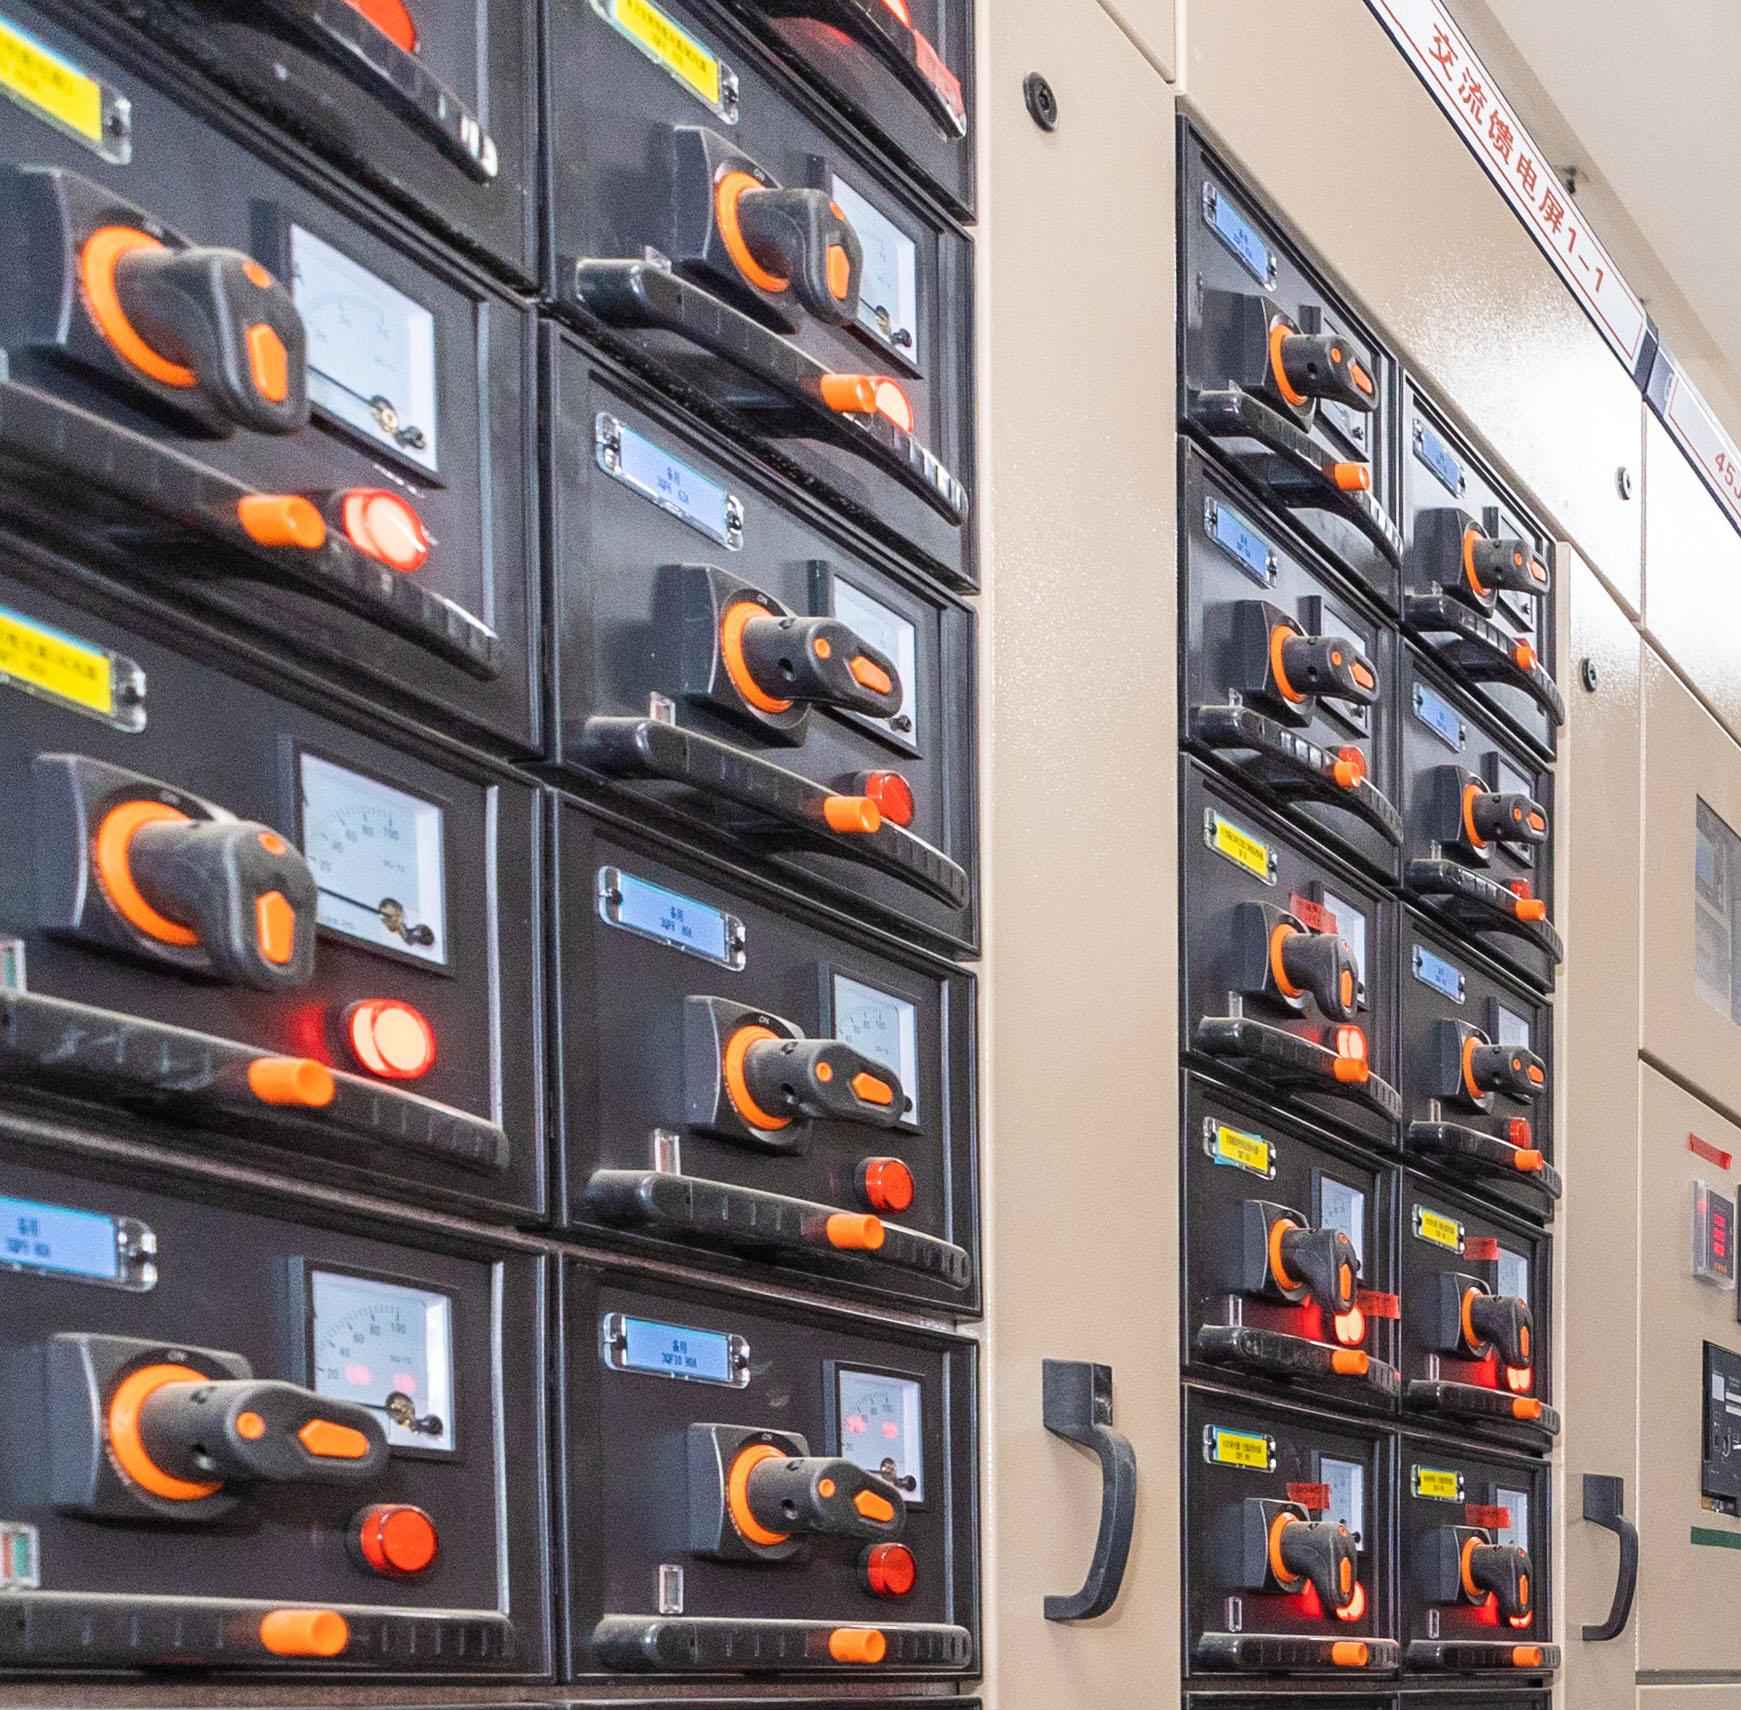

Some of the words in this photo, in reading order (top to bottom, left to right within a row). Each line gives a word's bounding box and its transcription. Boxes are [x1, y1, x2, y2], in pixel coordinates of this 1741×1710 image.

[1429, 24, 1605, 292] 交流馈电屏1-1
